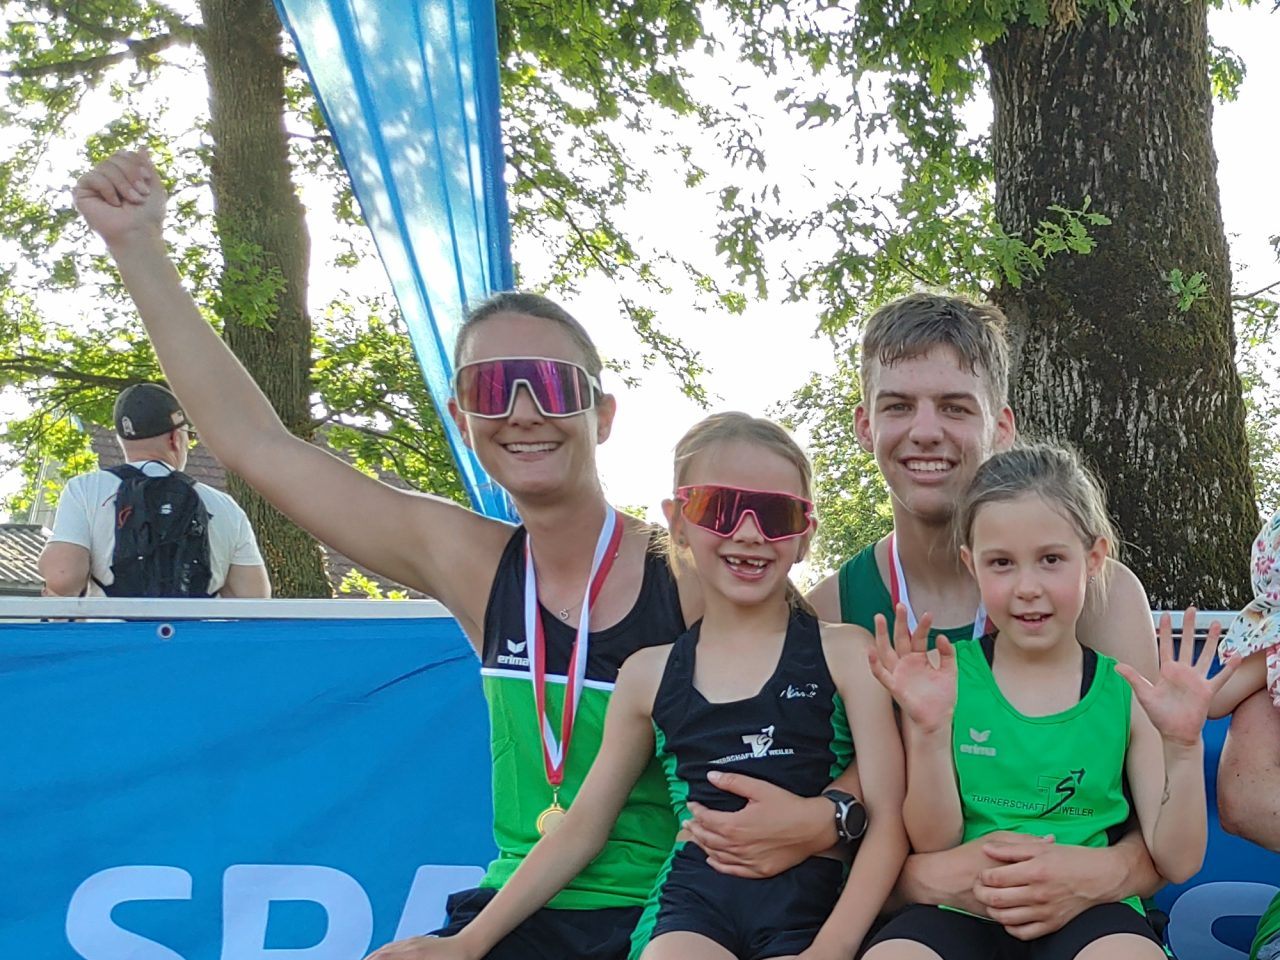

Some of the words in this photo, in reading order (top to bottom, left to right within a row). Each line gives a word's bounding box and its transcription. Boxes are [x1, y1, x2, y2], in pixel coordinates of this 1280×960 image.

[497, 655, 530, 666] erima
[972, 794, 1047, 812] TURNERSCHAFT
[1062, 806, 1094, 817] WEILER
